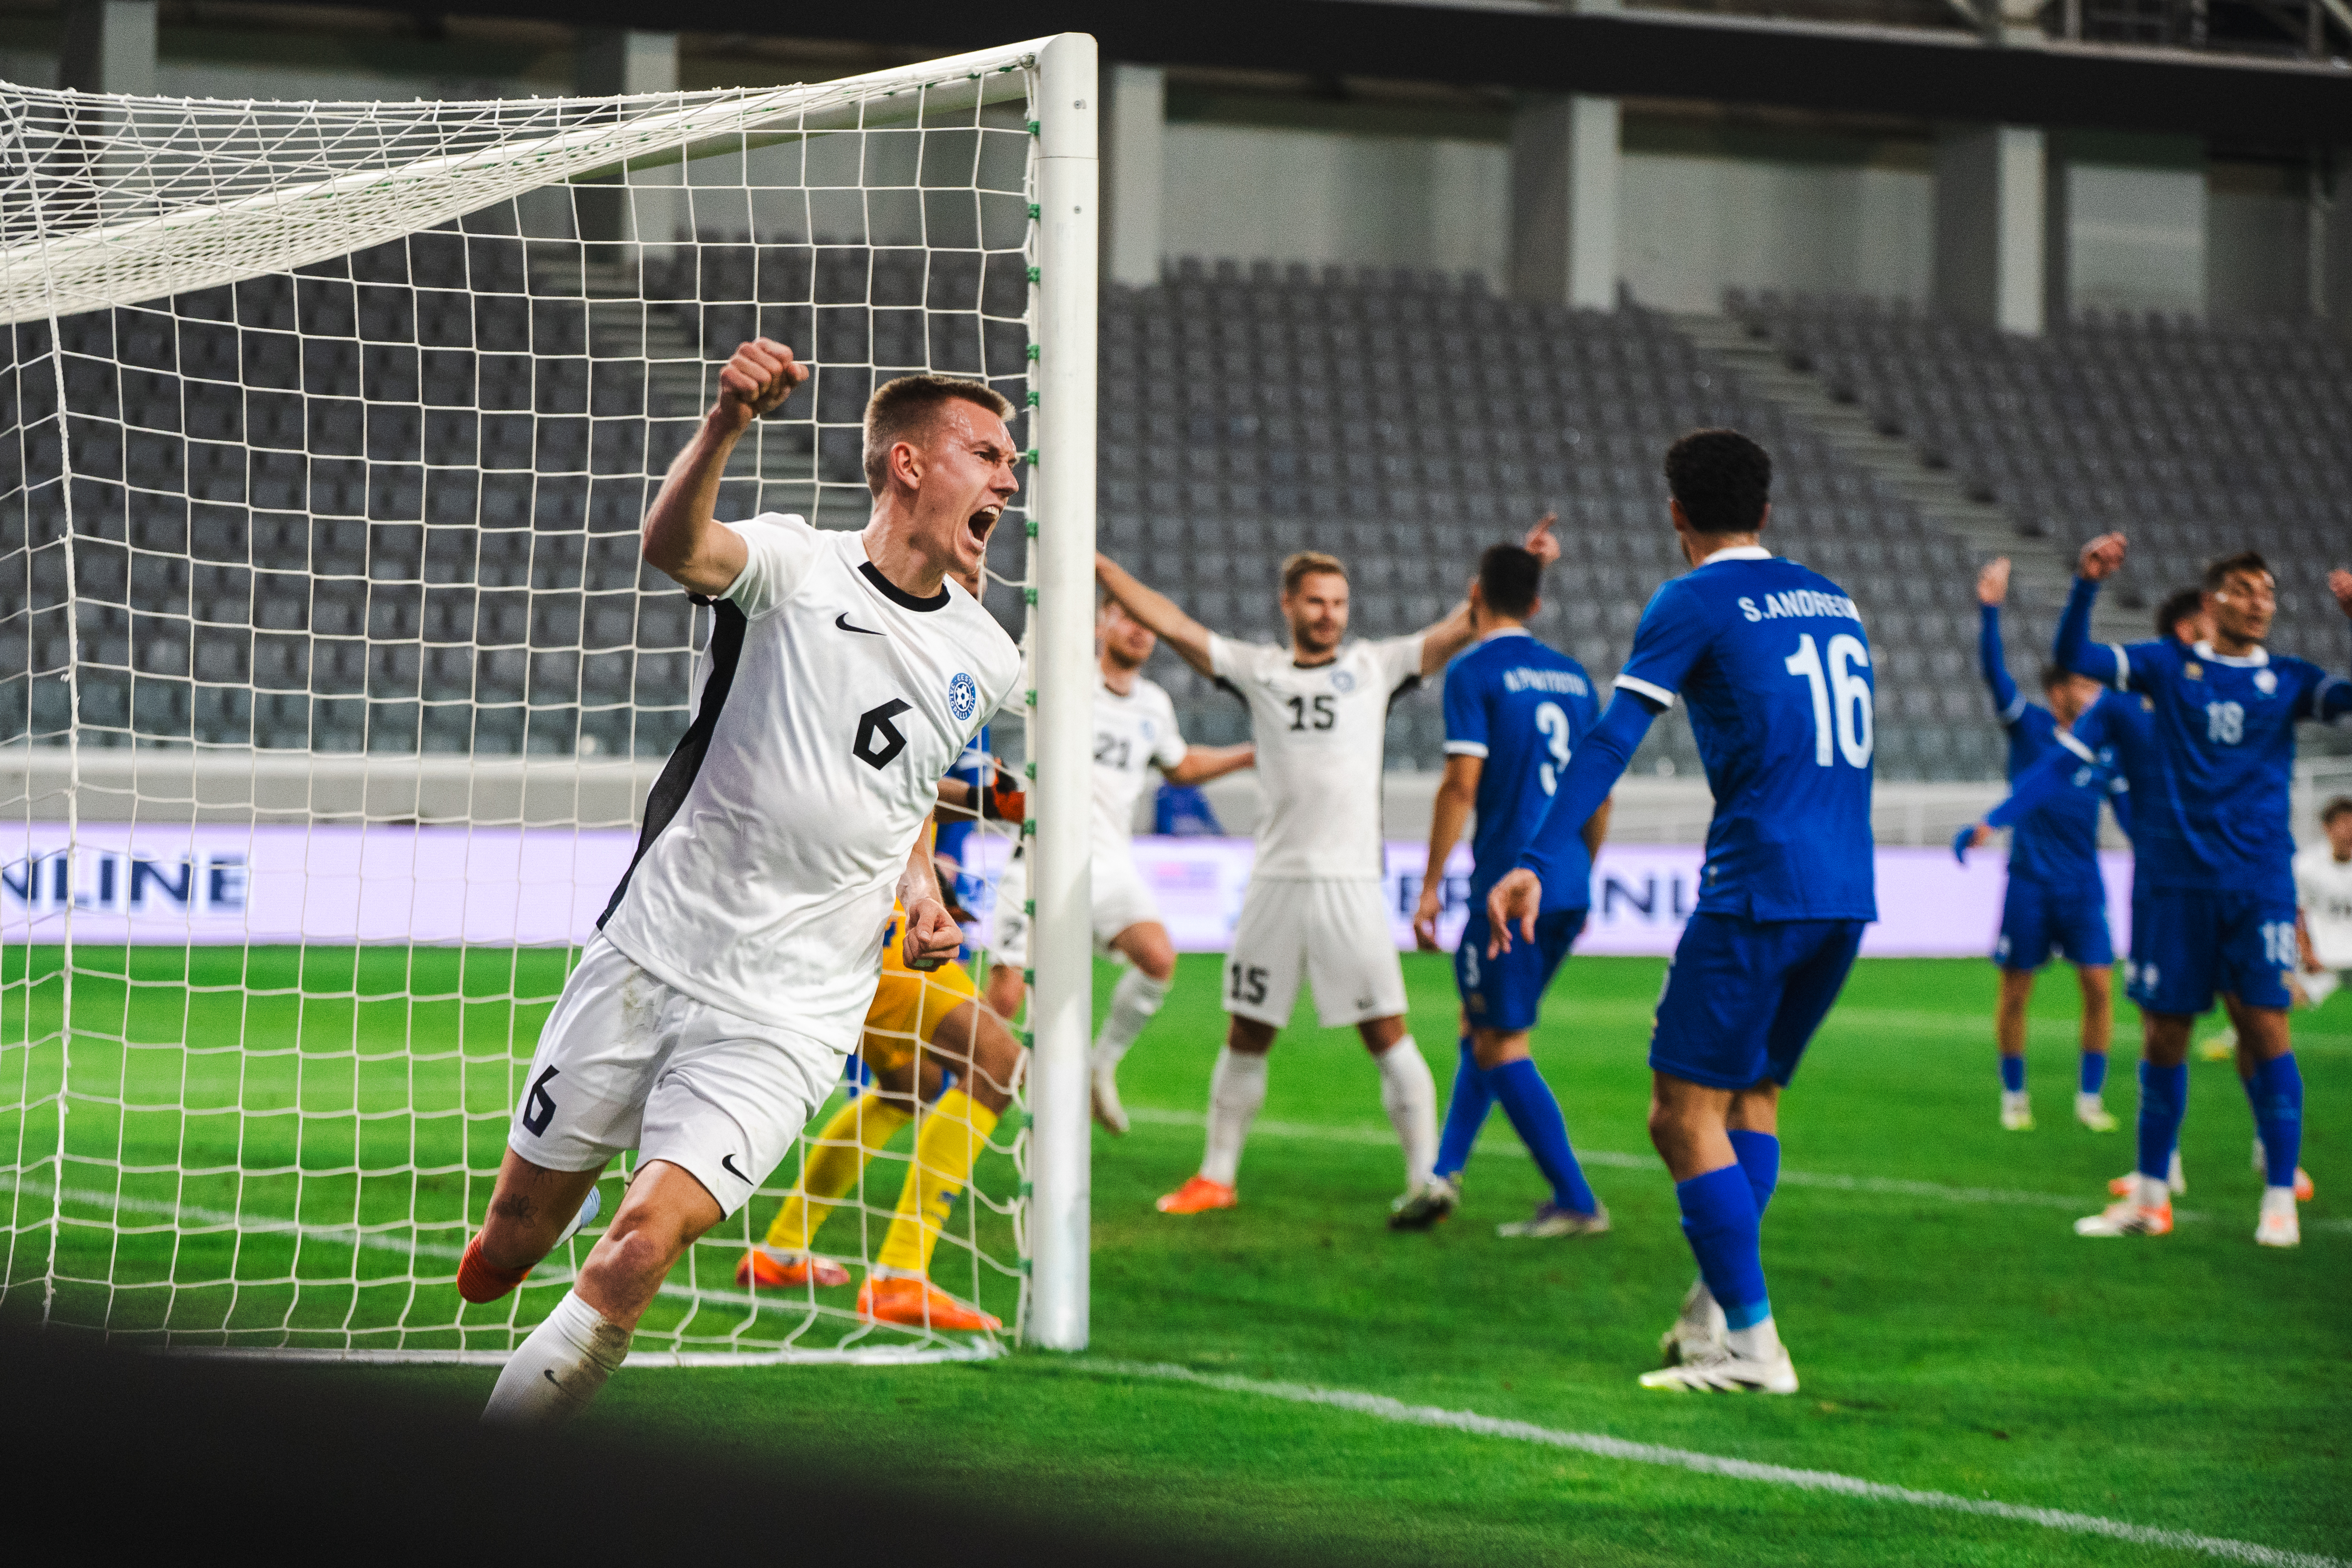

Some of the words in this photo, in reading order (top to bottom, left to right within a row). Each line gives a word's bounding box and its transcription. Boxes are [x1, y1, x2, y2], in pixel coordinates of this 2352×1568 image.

[957, 675, 973, 688] EESTI
[1785, 632, 1874, 769] 16
[853, 698, 913, 771] 6
[1287, 694, 1336, 732] 15
[1093, 731, 1132, 772] 21
[1535, 701, 1572, 797] 3
[0, 857, 249, 905] NLINE
[1229, 962, 1271, 1006] 15
[522, 1064, 560, 1138] 6
